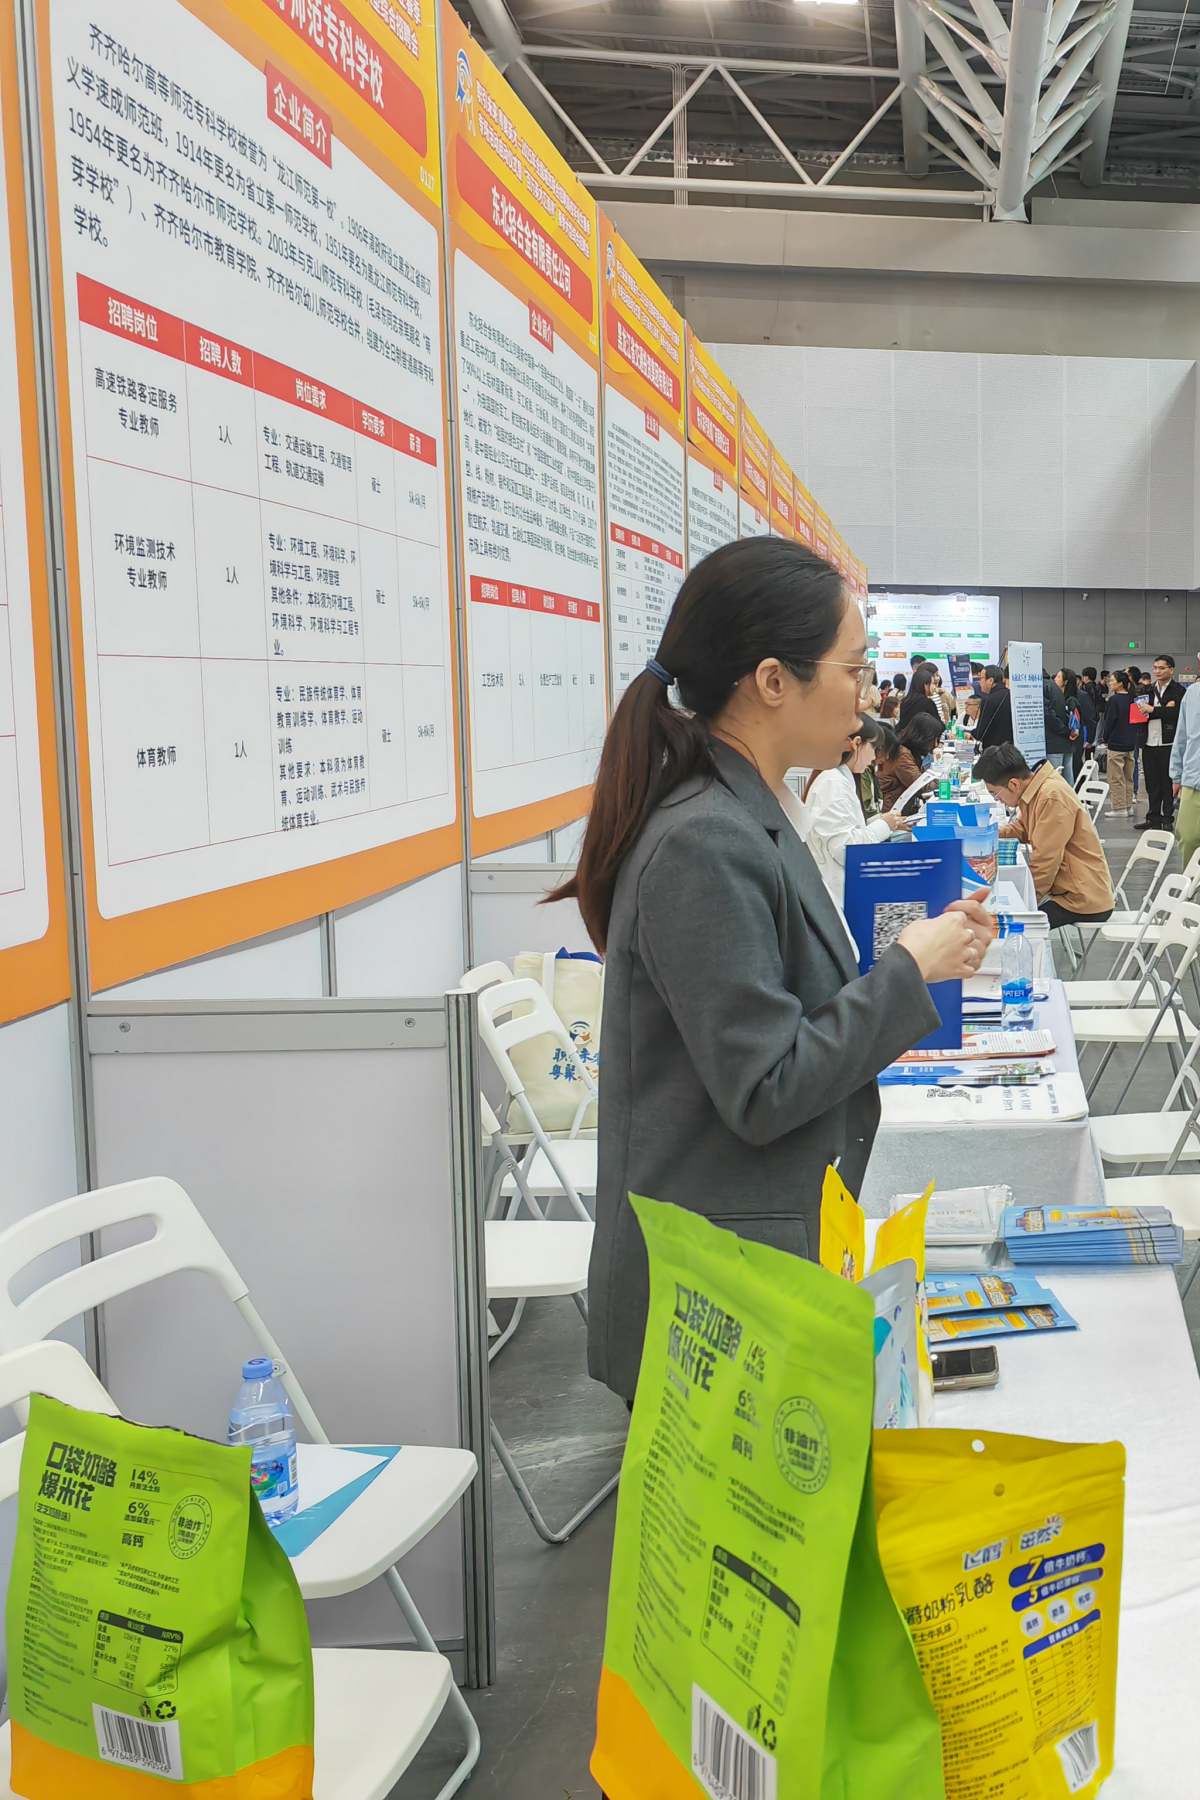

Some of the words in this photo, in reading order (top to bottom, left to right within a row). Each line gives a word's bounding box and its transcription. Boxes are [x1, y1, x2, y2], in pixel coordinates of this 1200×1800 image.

[273, 82, 328, 156] 企业简介
[73, 204, 109, 249] 学校。
[107, 296, 159, 343] 招聘岗位
[199, 336, 242, 376] 招聘人数
[94, 367, 178, 414] 高速铁路客运服务
[118, 407, 160, 439] 专业教师
[218, 424, 233, 447] 1人
[114, 533, 176, 561] 环境监测技术
[126, 567, 168, 593] 专业教师
[225, 565, 240, 585] 1人
[136, 746, 177, 768] 体育教师
[234, 740, 248, 759] 1人
[278, 737, 293, 755] 训练
[674, 1281, 743, 1361] 口袋奶酪
[46, 1441, 118, 1488] 口袋奶酪
[131, 1469, 159, 1486] 14%
[38, 1470, 95, 1512] 爆米花
[128, 1501, 150, 1517] 6%
[178, 1516, 203, 1532] 非油炸
[121, 1532, 145, 1548] 高钙
